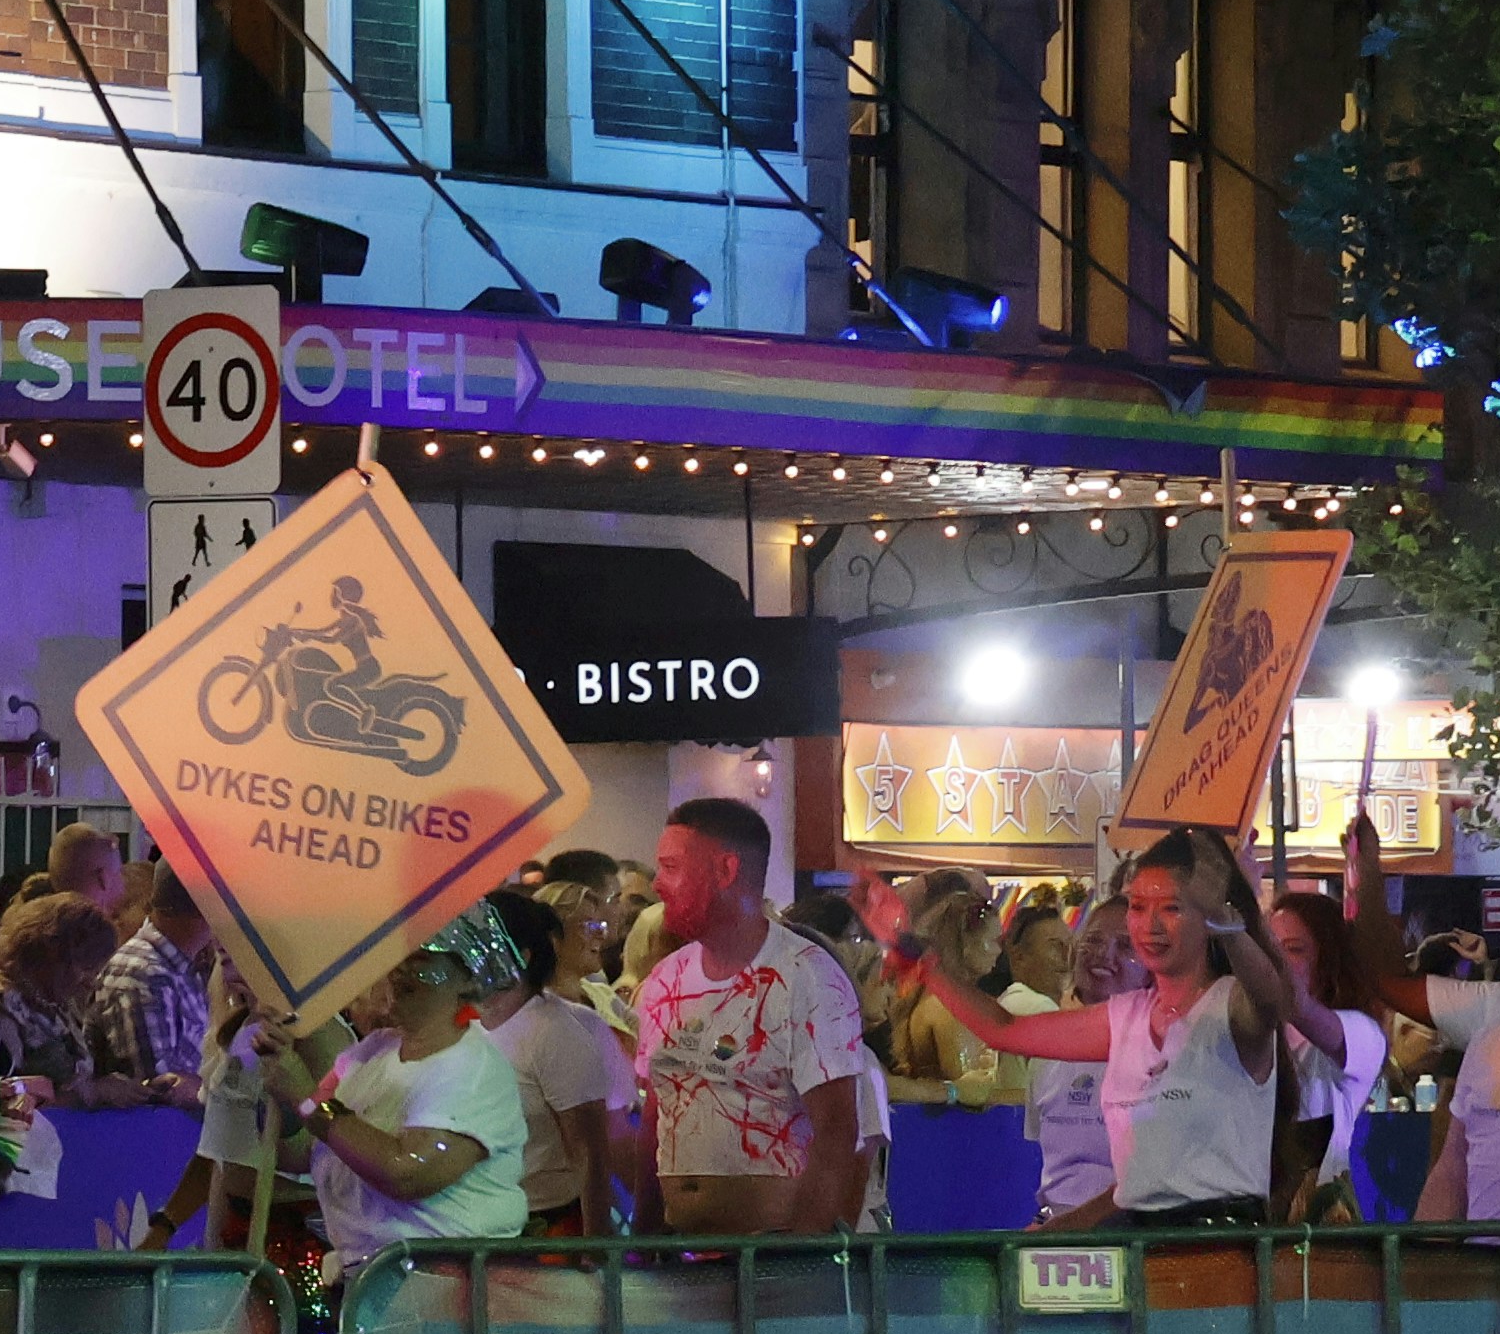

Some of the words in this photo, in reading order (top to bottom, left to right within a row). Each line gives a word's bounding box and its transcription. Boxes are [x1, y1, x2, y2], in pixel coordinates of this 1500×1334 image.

[166, 357, 257, 421] 40
[282, 323, 489, 414] OTEL
[576, 656, 761, 705] BISTRO
[1163, 740, 1213, 812] DRAG
[1198, 709, 1260, 796] AHEAD
[176, 758, 294, 811] DYKES
[302, 783, 356, 822] ON
[364, 794, 471, 844] BIKES
[873, 766, 895, 812] 5
[250, 818, 382, 870] AHEAD
[1031, 1254, 1104, 1287] TFH
